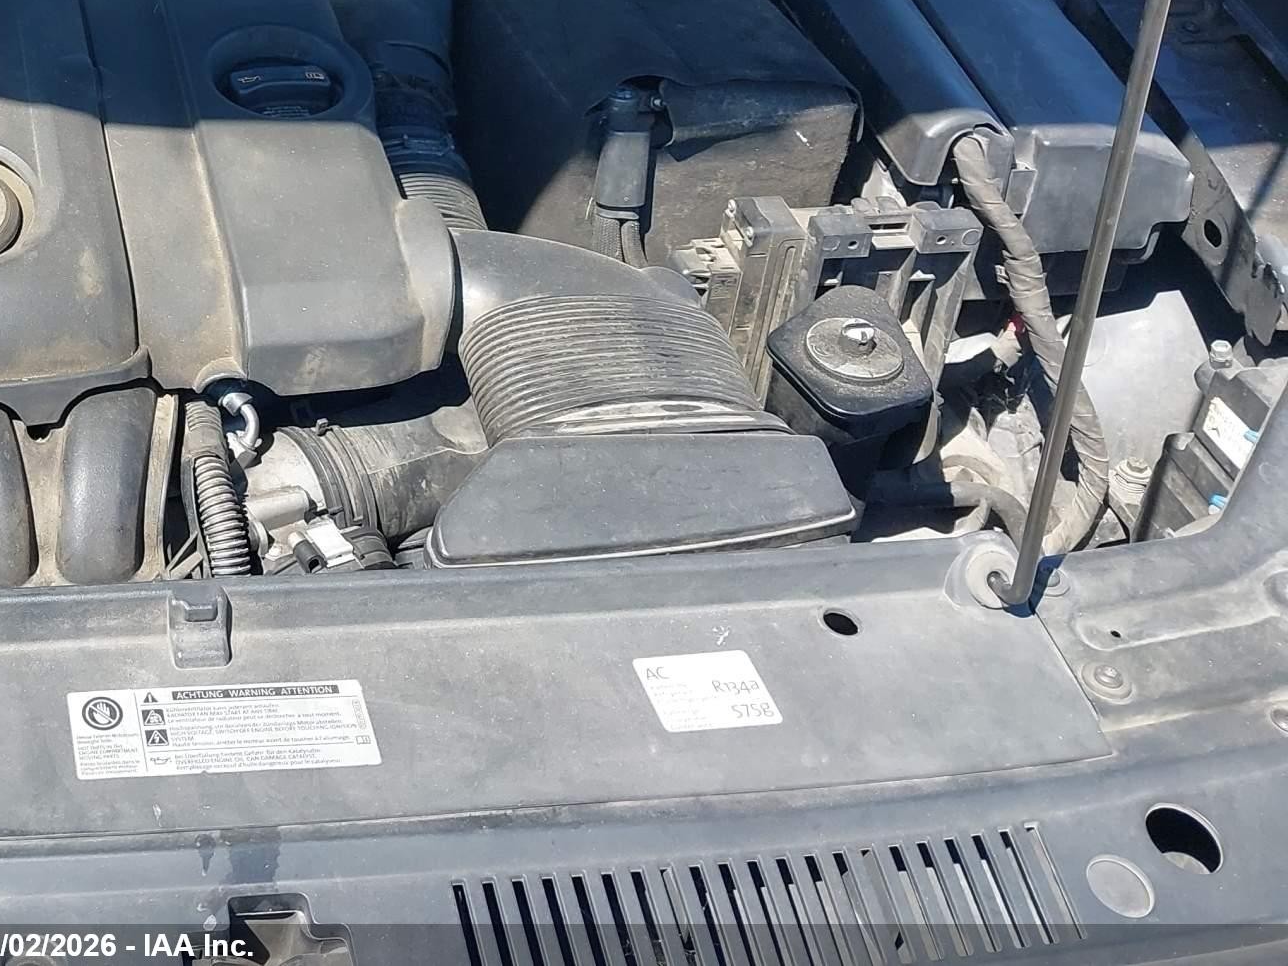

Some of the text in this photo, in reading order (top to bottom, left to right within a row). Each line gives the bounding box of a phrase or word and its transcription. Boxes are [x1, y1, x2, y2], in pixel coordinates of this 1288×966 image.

[645, 666, 669, 681] AC
[176, 685, 334, 700] ACHTUNG WARNING ATTENTION
[711, 679, 760, 694] R134a
